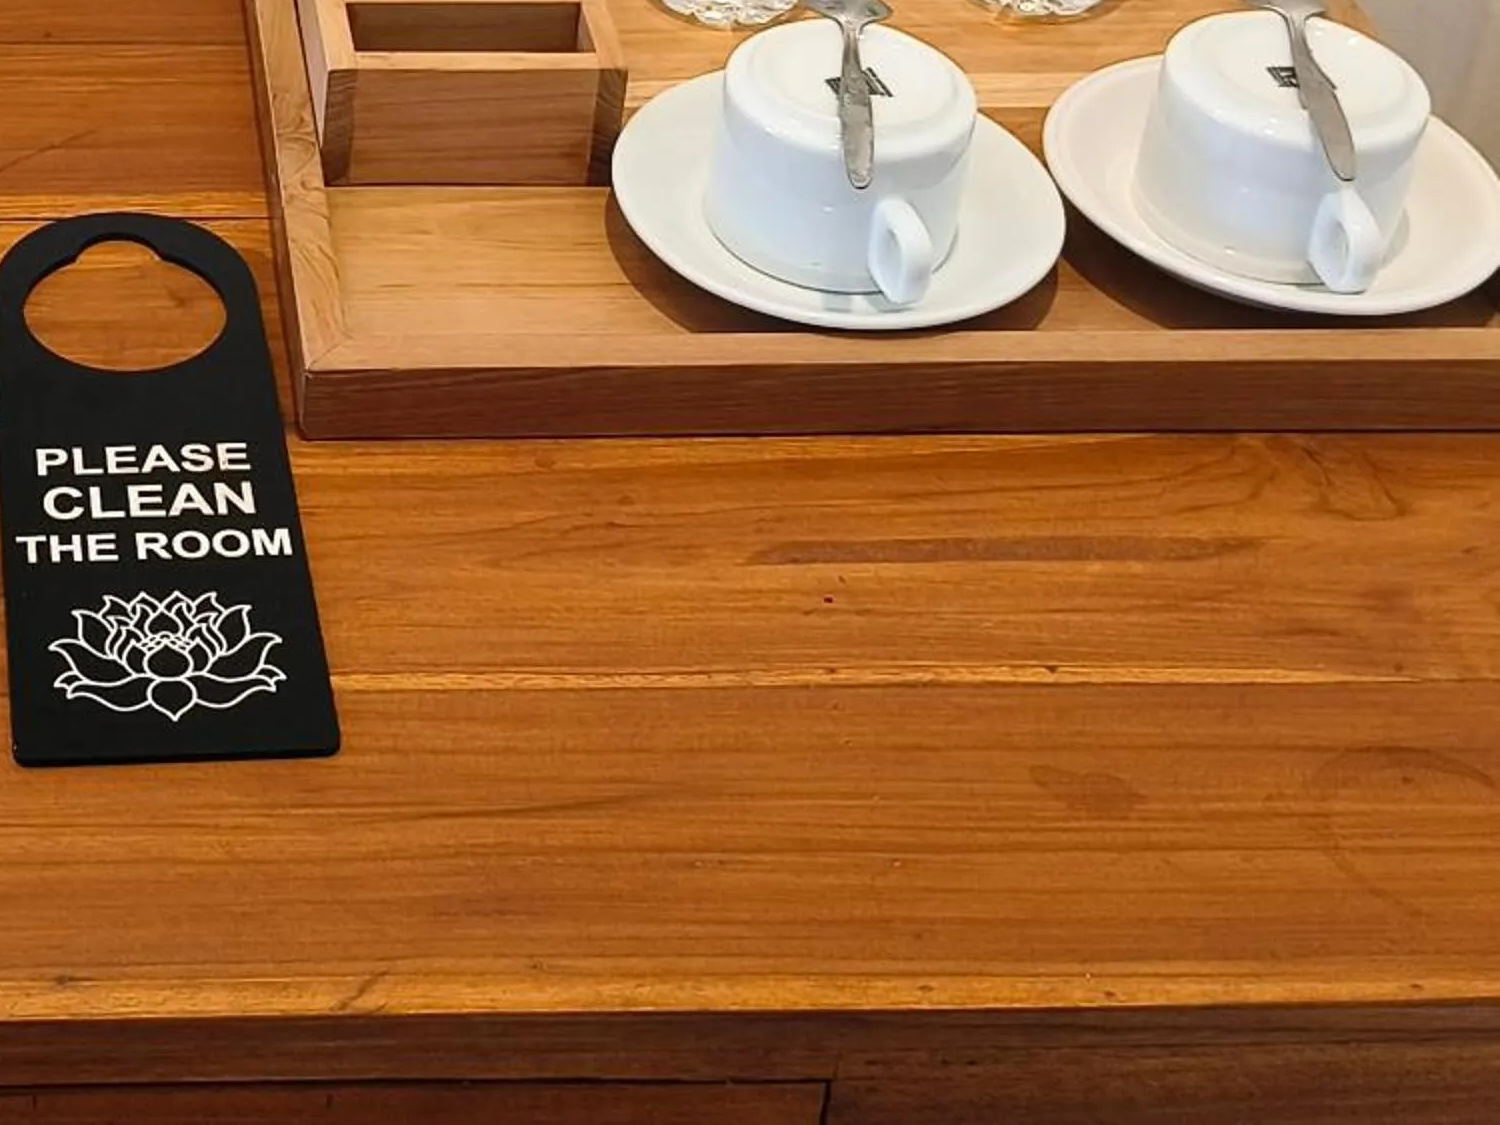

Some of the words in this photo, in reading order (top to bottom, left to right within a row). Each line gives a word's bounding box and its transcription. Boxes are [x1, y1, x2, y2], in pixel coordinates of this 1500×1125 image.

[35, 442, 251, 476] PLEASE
[42, 481, 256, 520] CLEAN
[15, 532, 119, 563] THE
[135, 528, 293, 560] ROOM
